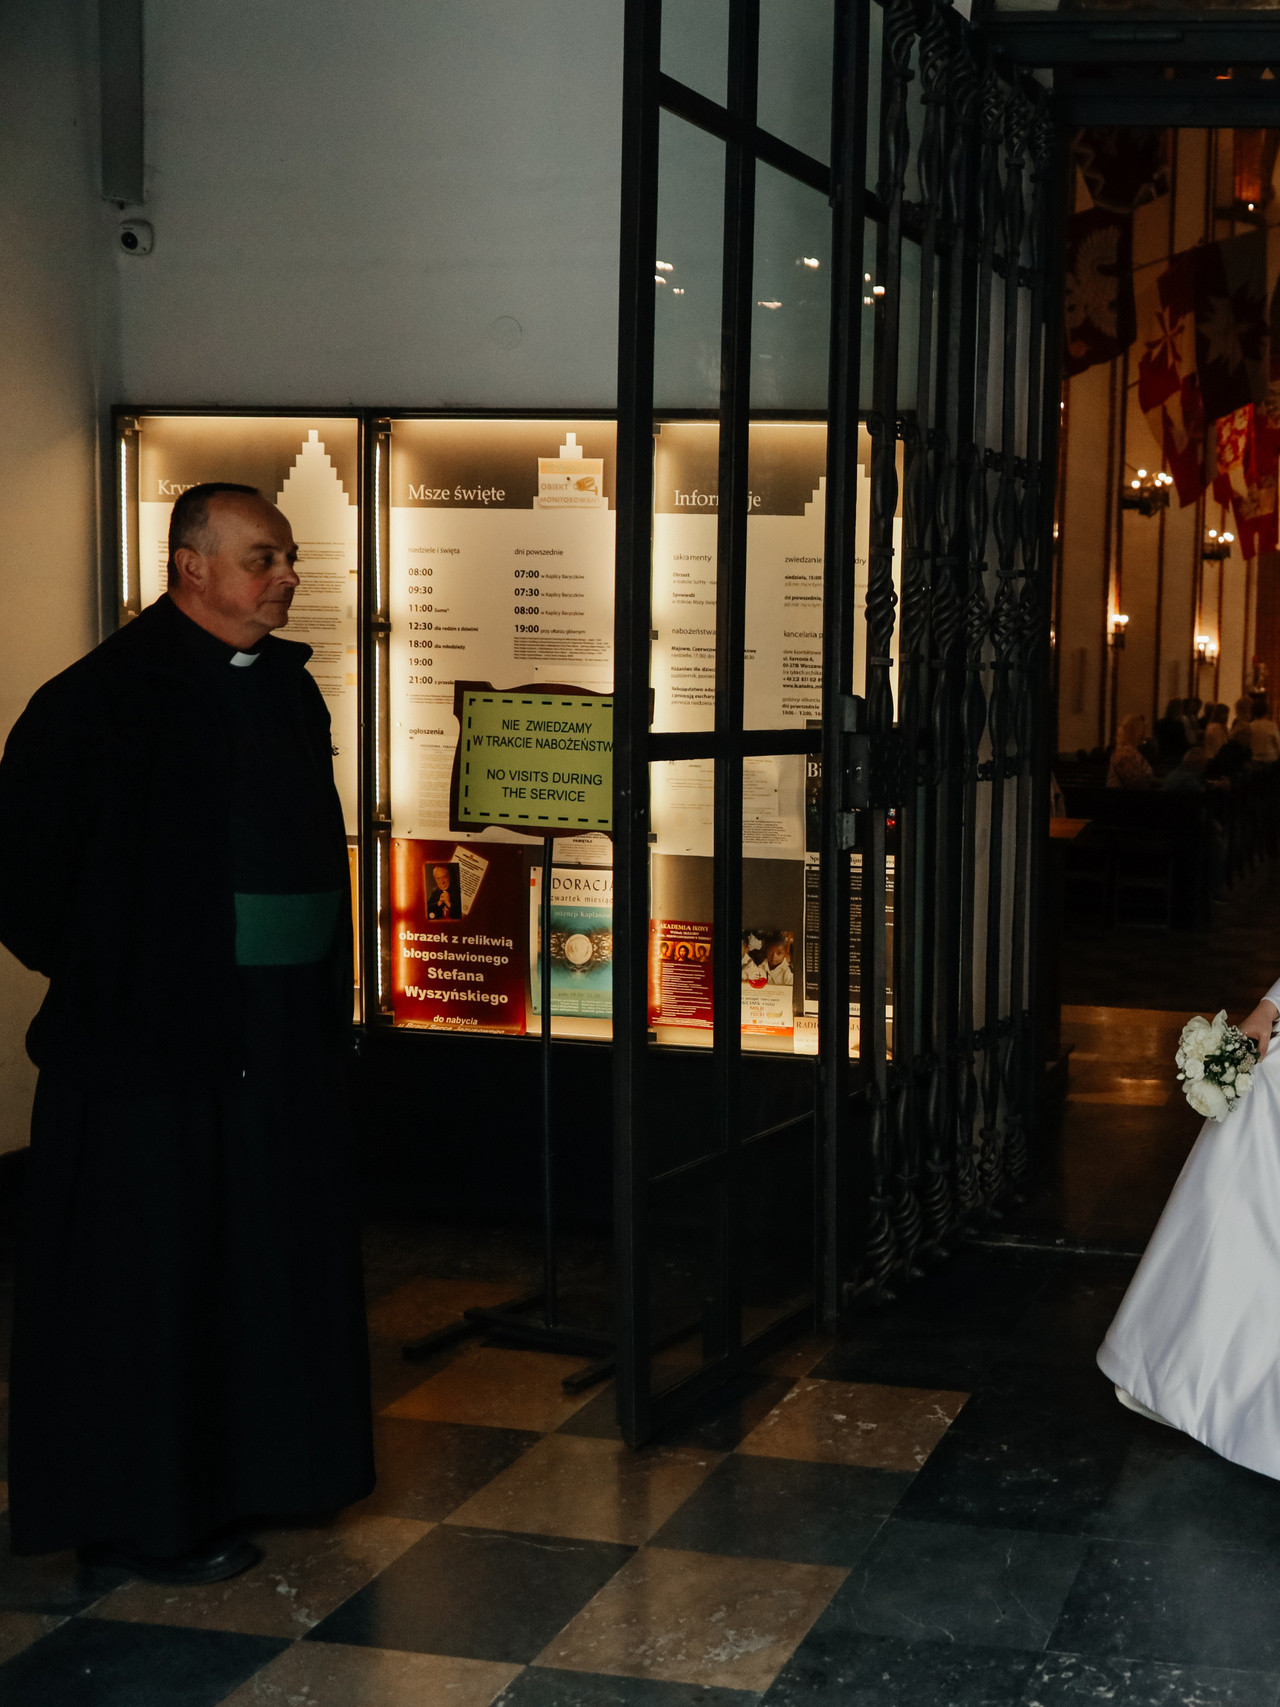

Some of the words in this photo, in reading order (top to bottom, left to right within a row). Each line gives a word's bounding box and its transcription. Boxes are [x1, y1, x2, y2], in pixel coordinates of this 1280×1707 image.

[540, 483, 569, 491] OBIEKT
[408, 484, 450, 500] Msze
[454, 485, 506, 504] święte
[440, 547, 461, 555] święta
[514, 548, 525, 556] dni
[525, 549, 564, 557] powszednie
[672, 553, 713, 562] sakramenty
[784, 555, 823, 564] zwiedzanie
[408, 568, 433, 577] 08:00
[514, 570, 540, 579] 07:00
[408, 586, 433, 595] 09:30
[514, 588, 540, 597] 07:30
[408, 604, 433, 613] 11:00
[514, 606, 540, 615] 08:00
[408, 622, 433, 631] 12:30
[514, 624, 540, 633] 19:00
[671, 627, 717, 636] nabożeństwa
[408, 640, 433, 649] 18:00
[408, 658, 433, 667] 19:00
[408, 676, 433, 685] 21:00
[502, 719, 520, 731] NIE
[525, 720, 592, 734] ZWIEDZAMY
[409, 727, 444, 736] ogłoszenia
[473, 735, 484, 746] W
[486, 736, 532, 748] TRAKCIE
[535, 736, 614, 753] NABOŻEŃSTW
[486, 769, 506, 780] NO
[508, 770, 548, 783] VISITS
[552, 772, 603, 786] DURING
[501, 786, 526, 799] THE
[530, 788, 585, 802] SERVICE
[552, 877, 613, 892] DORACJ
[551, 894, 581, 903] zwartek
[398, 930, 448, 943] obrazek
[451, 934, 459, 943] z
[462, 935, 514, 950] relikwią
[402, 947, 509, 966] błogosławionego
[427, 967, 485, 982] Stefana
[404, 985, 509, 1006] Wyszyńskiego
[433, 1014, 445, 1023] do
[446, 1016, 478, 1026] nabycia
